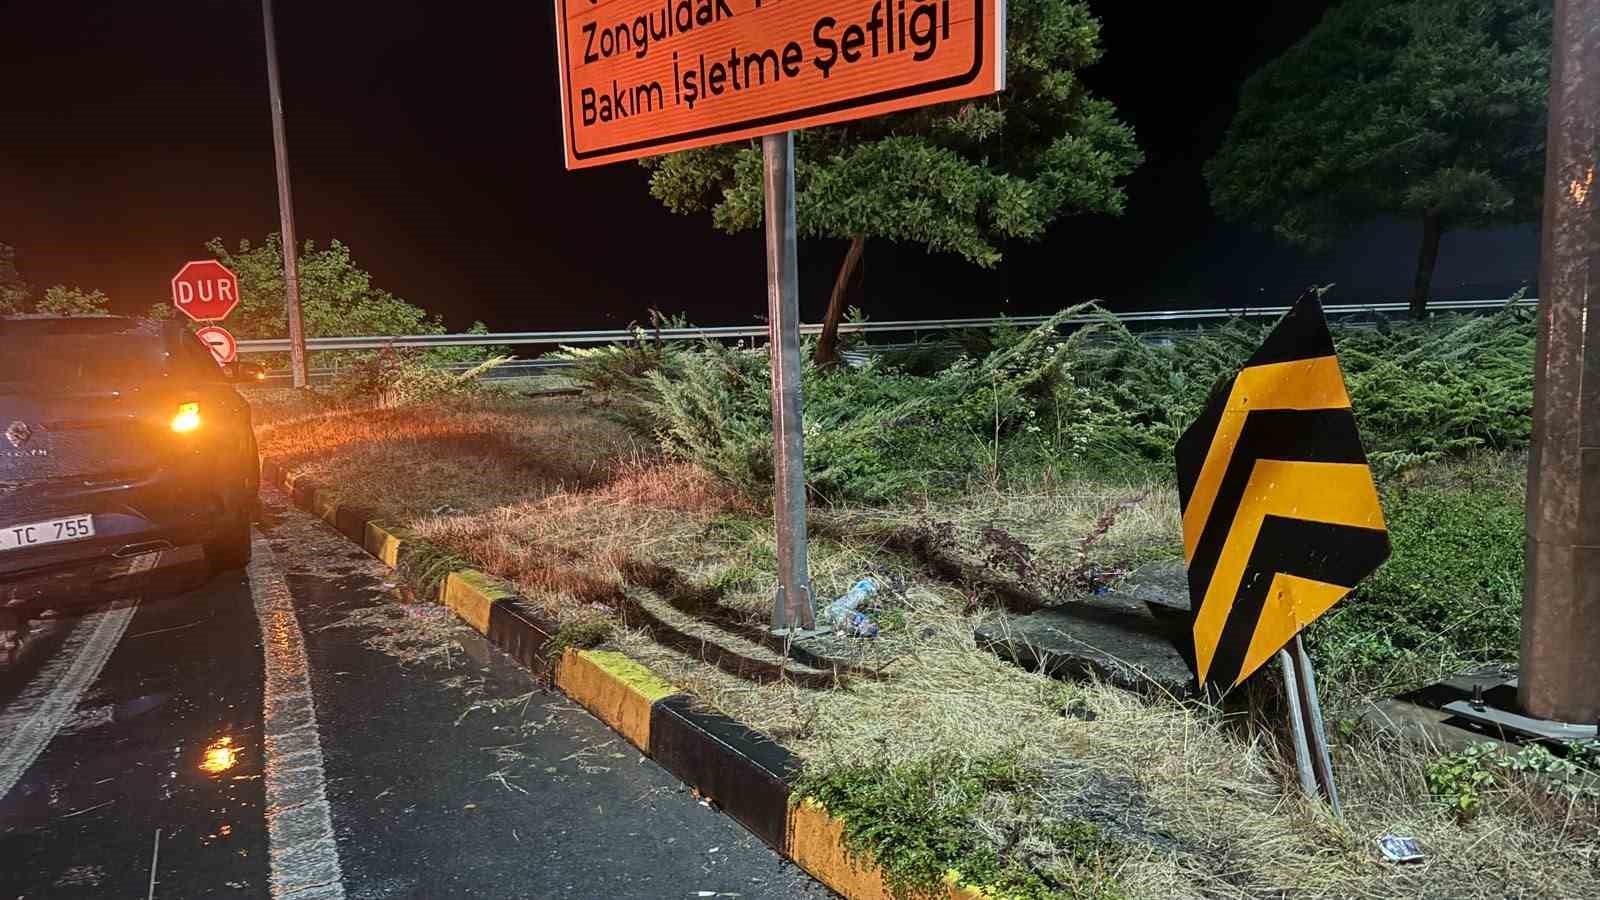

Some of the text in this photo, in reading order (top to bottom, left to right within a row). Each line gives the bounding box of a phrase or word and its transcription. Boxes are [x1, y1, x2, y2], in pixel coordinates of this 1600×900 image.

[581, 79, 664, 127] Bakım
[672, 41, 803, 109] İşletme
[178, 278, 234, 304] DUR
[12, 519, 89, 545] TC 755
